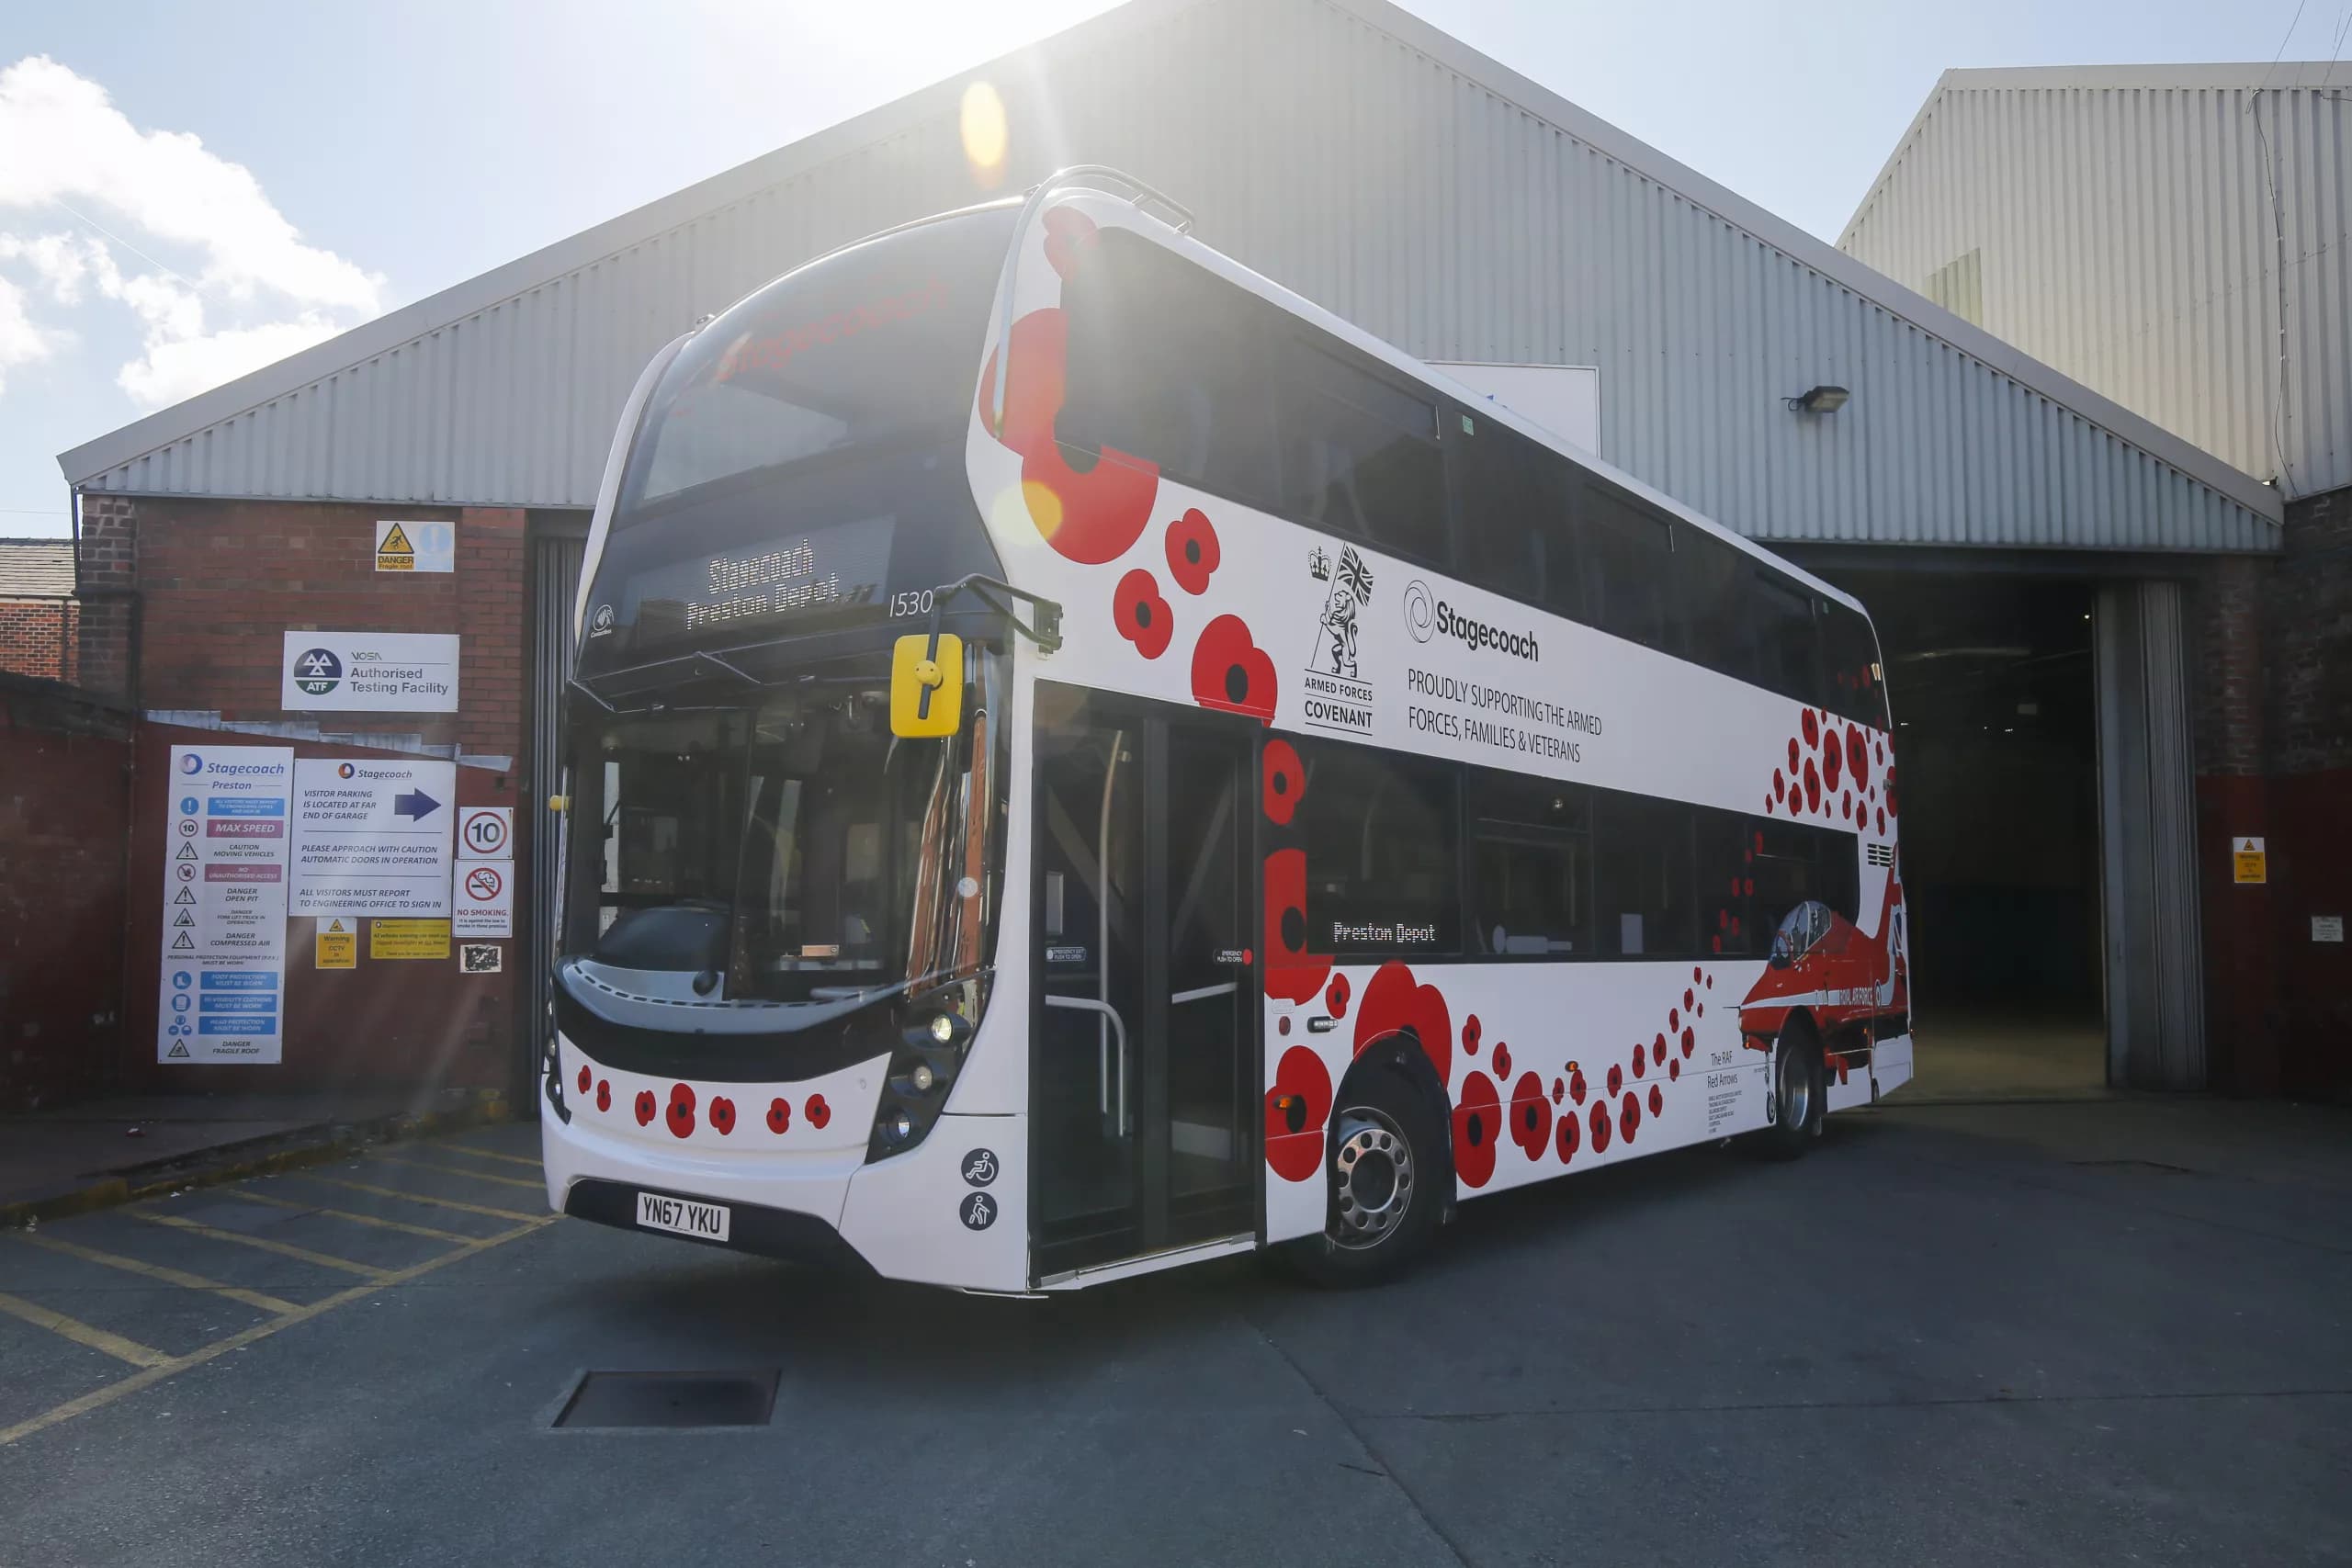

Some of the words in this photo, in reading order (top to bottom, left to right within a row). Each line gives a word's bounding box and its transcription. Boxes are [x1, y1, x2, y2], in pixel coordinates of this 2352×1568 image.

[708, 538, 813, 594] Stagecoach
[687, 593, 768, 630] Preston
[775, 572, 839, 613] Depot
[1436, 600, 1539, 662] Stagecoach
[351, 668, 423, 679] Authorised
[306, 682, 328, 692] ATF
[351, 682, 397, 695] Testing
[402, 682, 449, 695] Facility
[1305, 677, 1337, 694] ARMED
[1340, 684, 1373, 701] FORCES
[1408, 668, 1468, 704] PROUDLY
[1471, 684, 1543, 722] SUPPORTING
[1544, 703, 1565, 727] THE
[1566, 710, 1602, 735] ARMED
[1305, 700, 1373, 728] COVENANT
[1408, 706, 1462, 741] FORCES,
[1464, 718, 1516, 750] FAMILIES
[1518, 730, 1527, 752] &
[1527, 732, 1580, 763] VETERANS
[207, 763, 284, 776] Stagecoach
[358, 770, 412, 779] Stagecoach
[212, 781, 251, 790] Preston
[216, 824, 241, 832] MAX
[242, 824, 275, 832] SPEED
[471, 823, 500, 843] 10
[301, 856, 349, 864] AUTOMATIC
[351, 856, 379, 864] DOORS
[381, 856, 390, 864] IN
[392, 856, 438, 864] OPERATION
[1334, 922, 1392, 942] Preston
[1396, 923, 1435, 943] Depot
[1711, 1053, 1721, 1066] The
[1722, 1051, 1732, 1064] RAF
[1708, 1073, 1718, 1088] Red
[1719, 1073, 1738, 1087] Arrows
[644, 1196, 683, 1227] YN67
[688, 1205, 721, 1234] YKU
